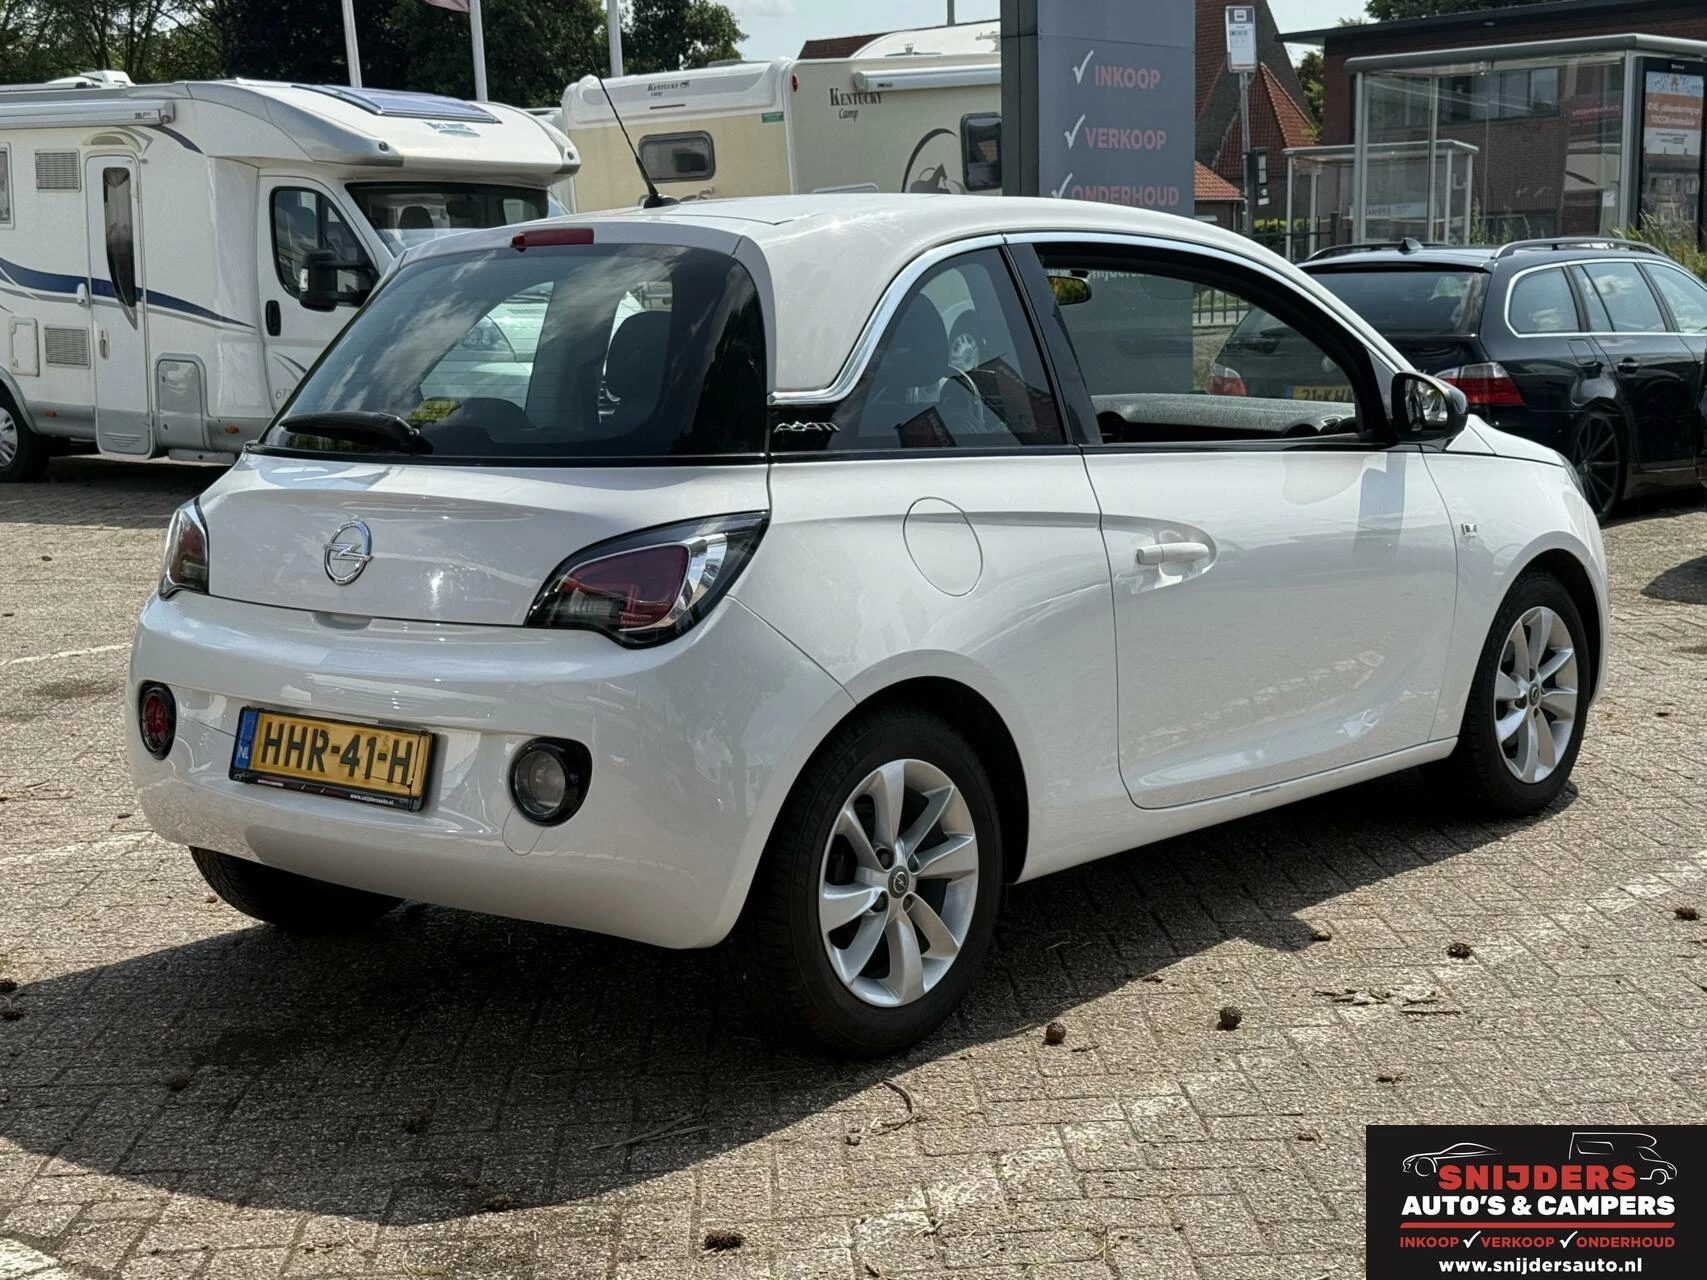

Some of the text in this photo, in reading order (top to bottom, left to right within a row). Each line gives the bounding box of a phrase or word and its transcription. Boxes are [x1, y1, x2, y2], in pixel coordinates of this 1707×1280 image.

[1095, 65, 1161, 89] INKOOP
[838, 107, 859, 122] Camp
[1084, 127, 1168, 150] VERKOOP
[1071, 184, 1180, 206] ONDERHOUD
[238, 746, 250, 760] NL
[261, 721, 413, 787] HHR-41-H
